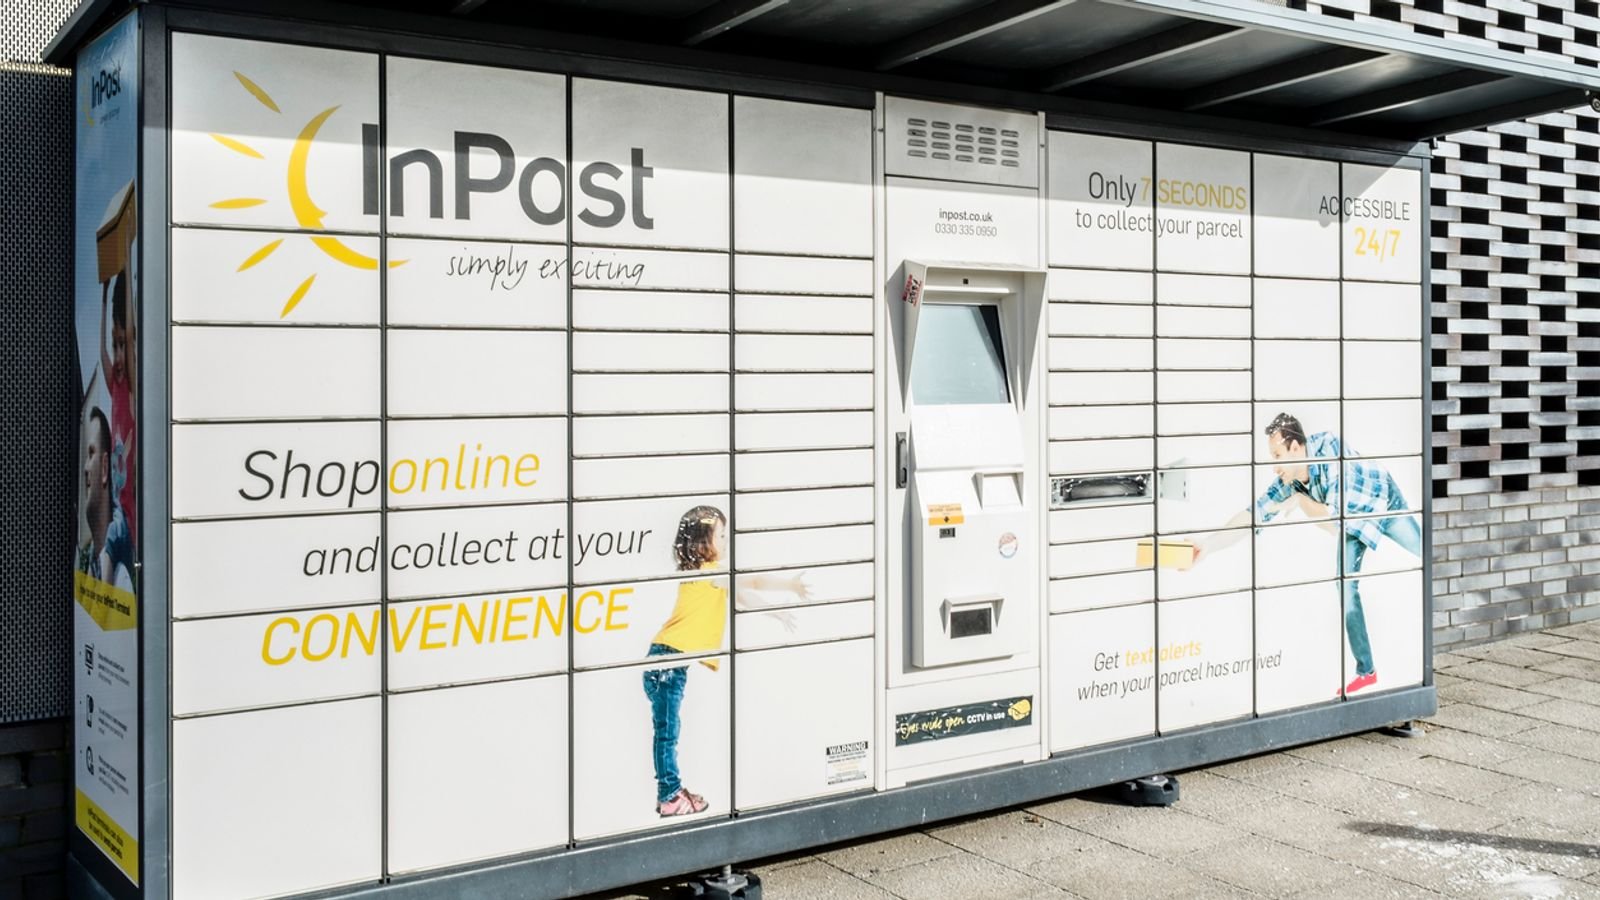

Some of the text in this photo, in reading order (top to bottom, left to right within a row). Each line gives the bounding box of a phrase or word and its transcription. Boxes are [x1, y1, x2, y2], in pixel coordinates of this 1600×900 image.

[91, 65, 121, 109] InPost
[362, 123, 654, 230] InPost
[1088, 171, 1137, 207] Only
[1158, 179, 1248, 211] SECONDS
[938, 207, 994, 222] inpost.co.uk
[1075, 208, 1243, 240] to collect your parcel
[1318, 195, 1411, 222] ACCESSIBLE
[934, 222, 998, 237] 0330 335 0950
[1353, 226, 1401, 263] 24/7
[446, 246, 645, 291] simply exciting
[238, 443, 541, 508] Shop online
[302, 527, 652, 577] and collect at your
[260, 587, 635, 667] CONVENIENCE
[1094, 640, 1202, 671] Get text alerts
[1077, 649, 1283, 701] when your parcel has arrived
[966, 712, 986, 724] CCTV
[828, 741, 867, 755] WARNING
